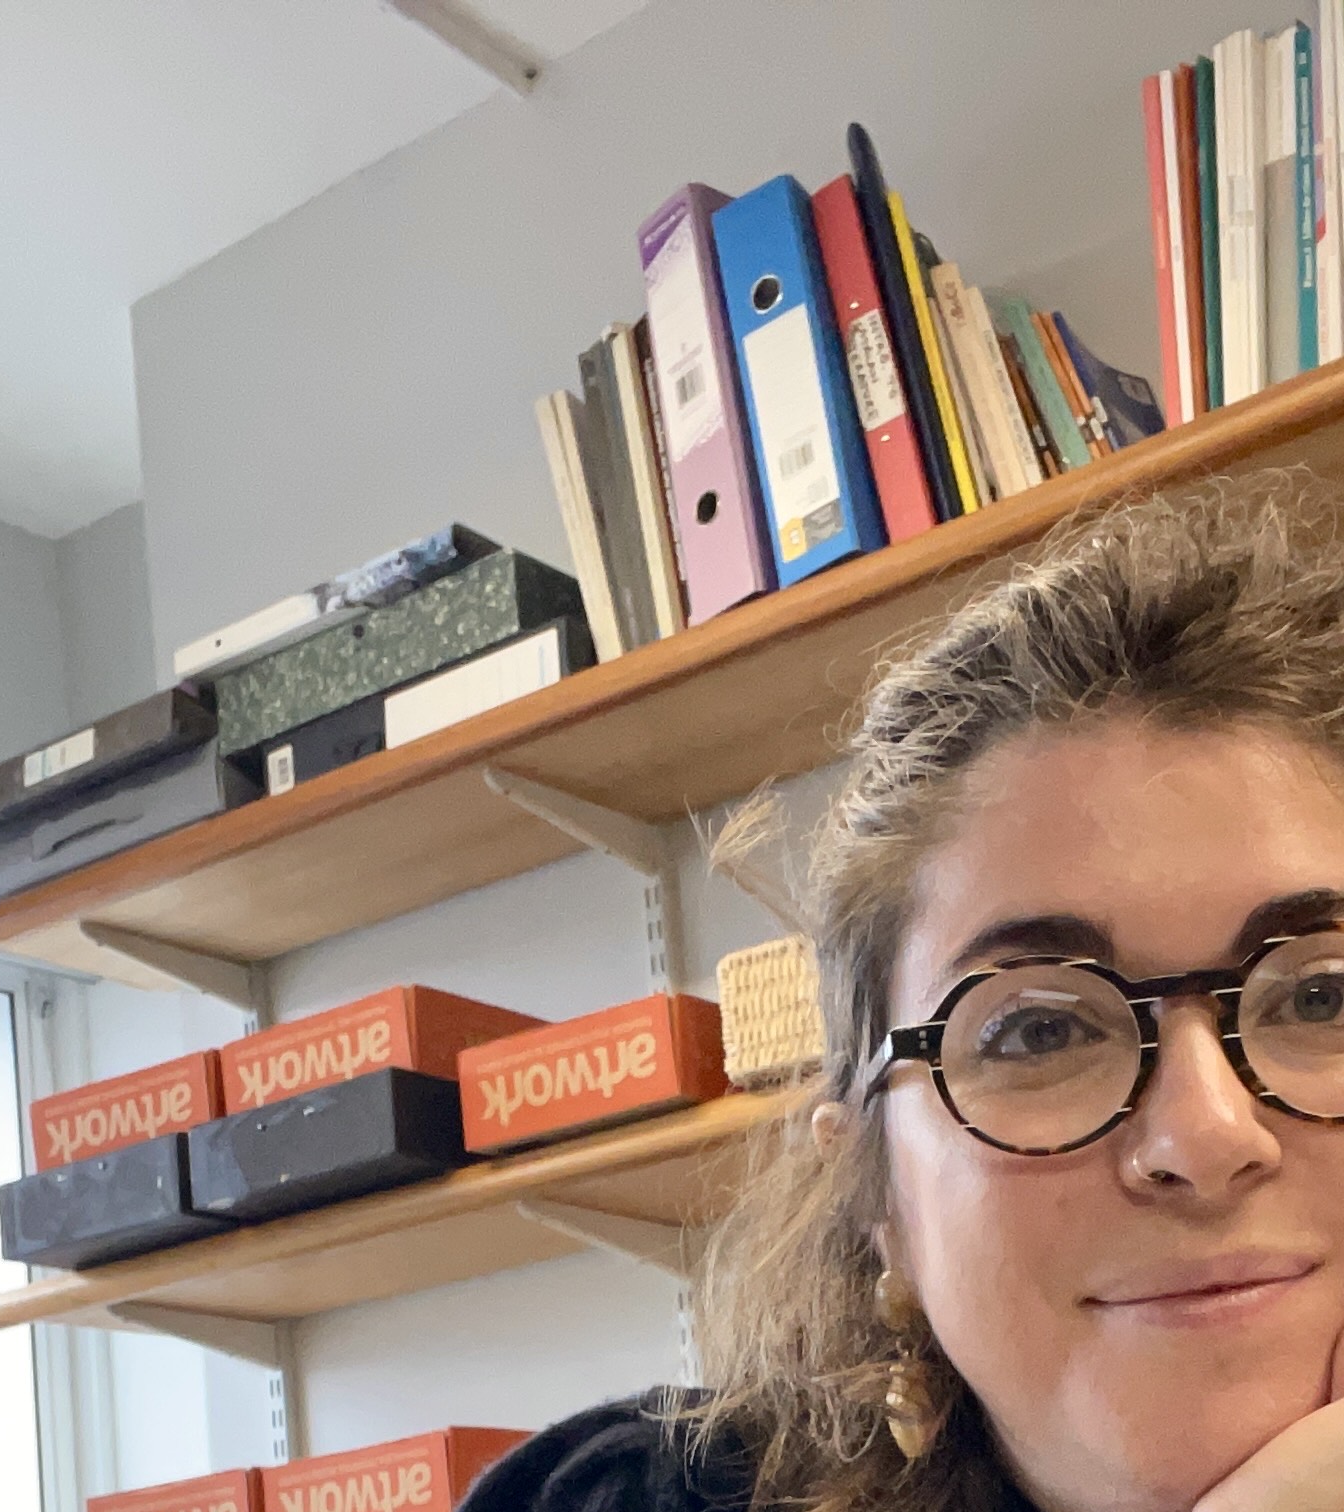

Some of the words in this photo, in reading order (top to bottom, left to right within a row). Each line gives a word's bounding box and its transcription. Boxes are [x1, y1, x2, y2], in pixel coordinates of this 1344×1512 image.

[237, 1020, 391, 1107] artwork
[478, 1033, 656, 1128] artwork
[46, 1082, 192, 1163] artwork
